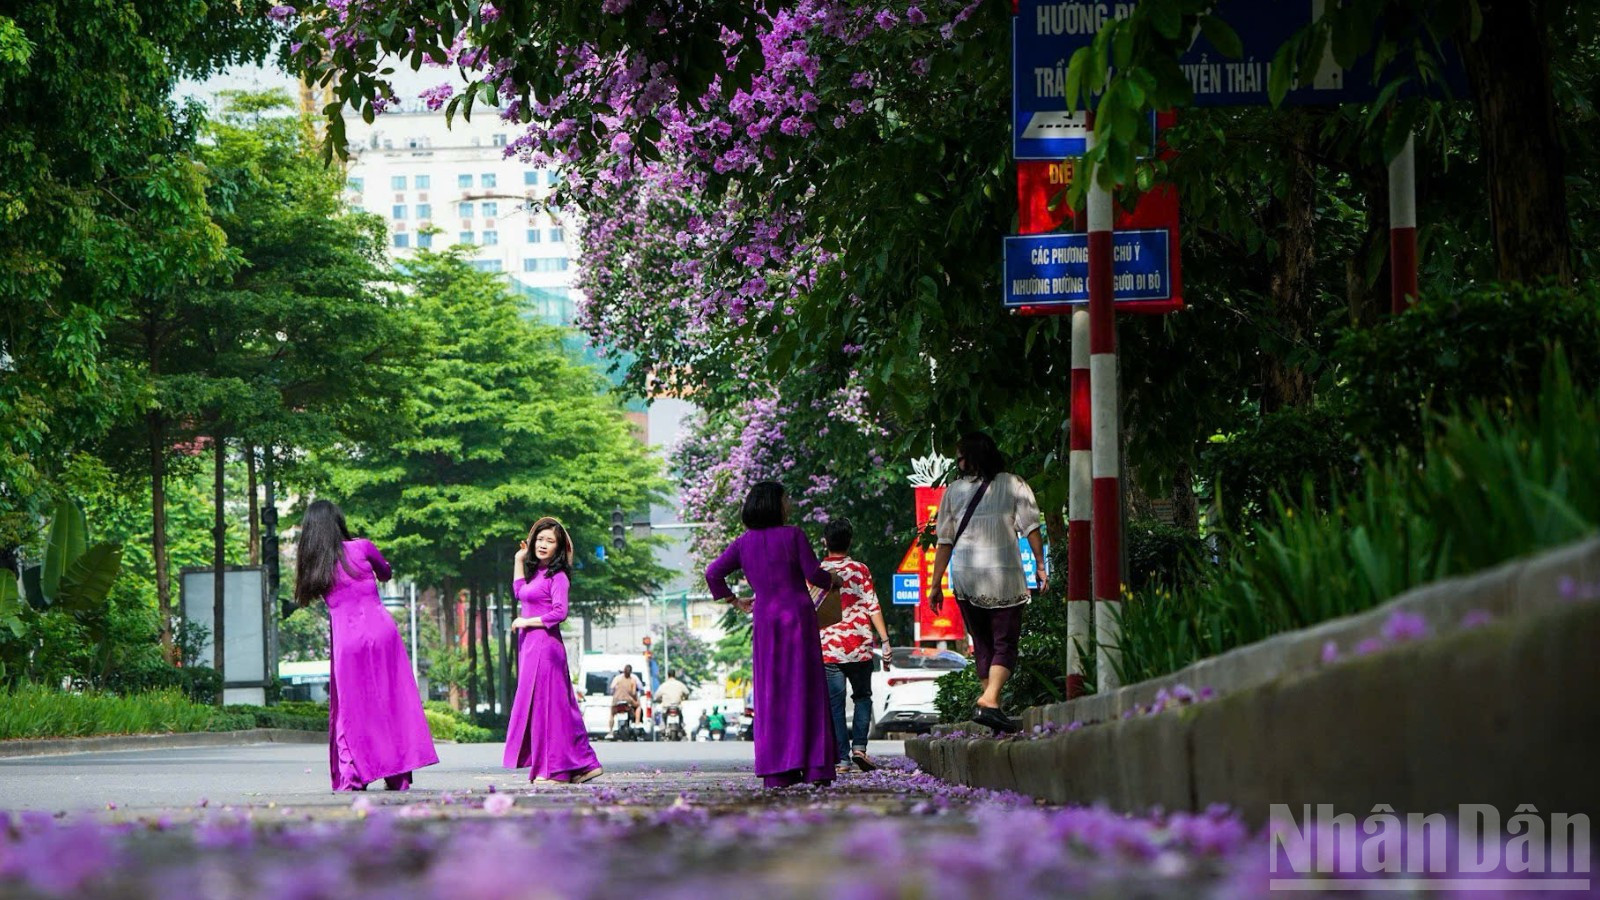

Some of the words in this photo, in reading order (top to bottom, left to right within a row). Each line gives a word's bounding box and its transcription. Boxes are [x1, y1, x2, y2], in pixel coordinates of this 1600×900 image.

[1034, 58, 1069, 98] TRẦ
[1225, 56, 1262, 93] THÁI
[1031, 246, 1050, 265] CÁC
[1114, 242, 1132, 262] CHÚ
[1134, 241, 1141, 261] Ý
[1052, 273, 1084, 294] ĐƯỜNG
[1114, 270, 1134, 291] GƯỜI
[1136, 273, 1146, 291] ĐI
[1148, 270, 1161, 293] BỘ
